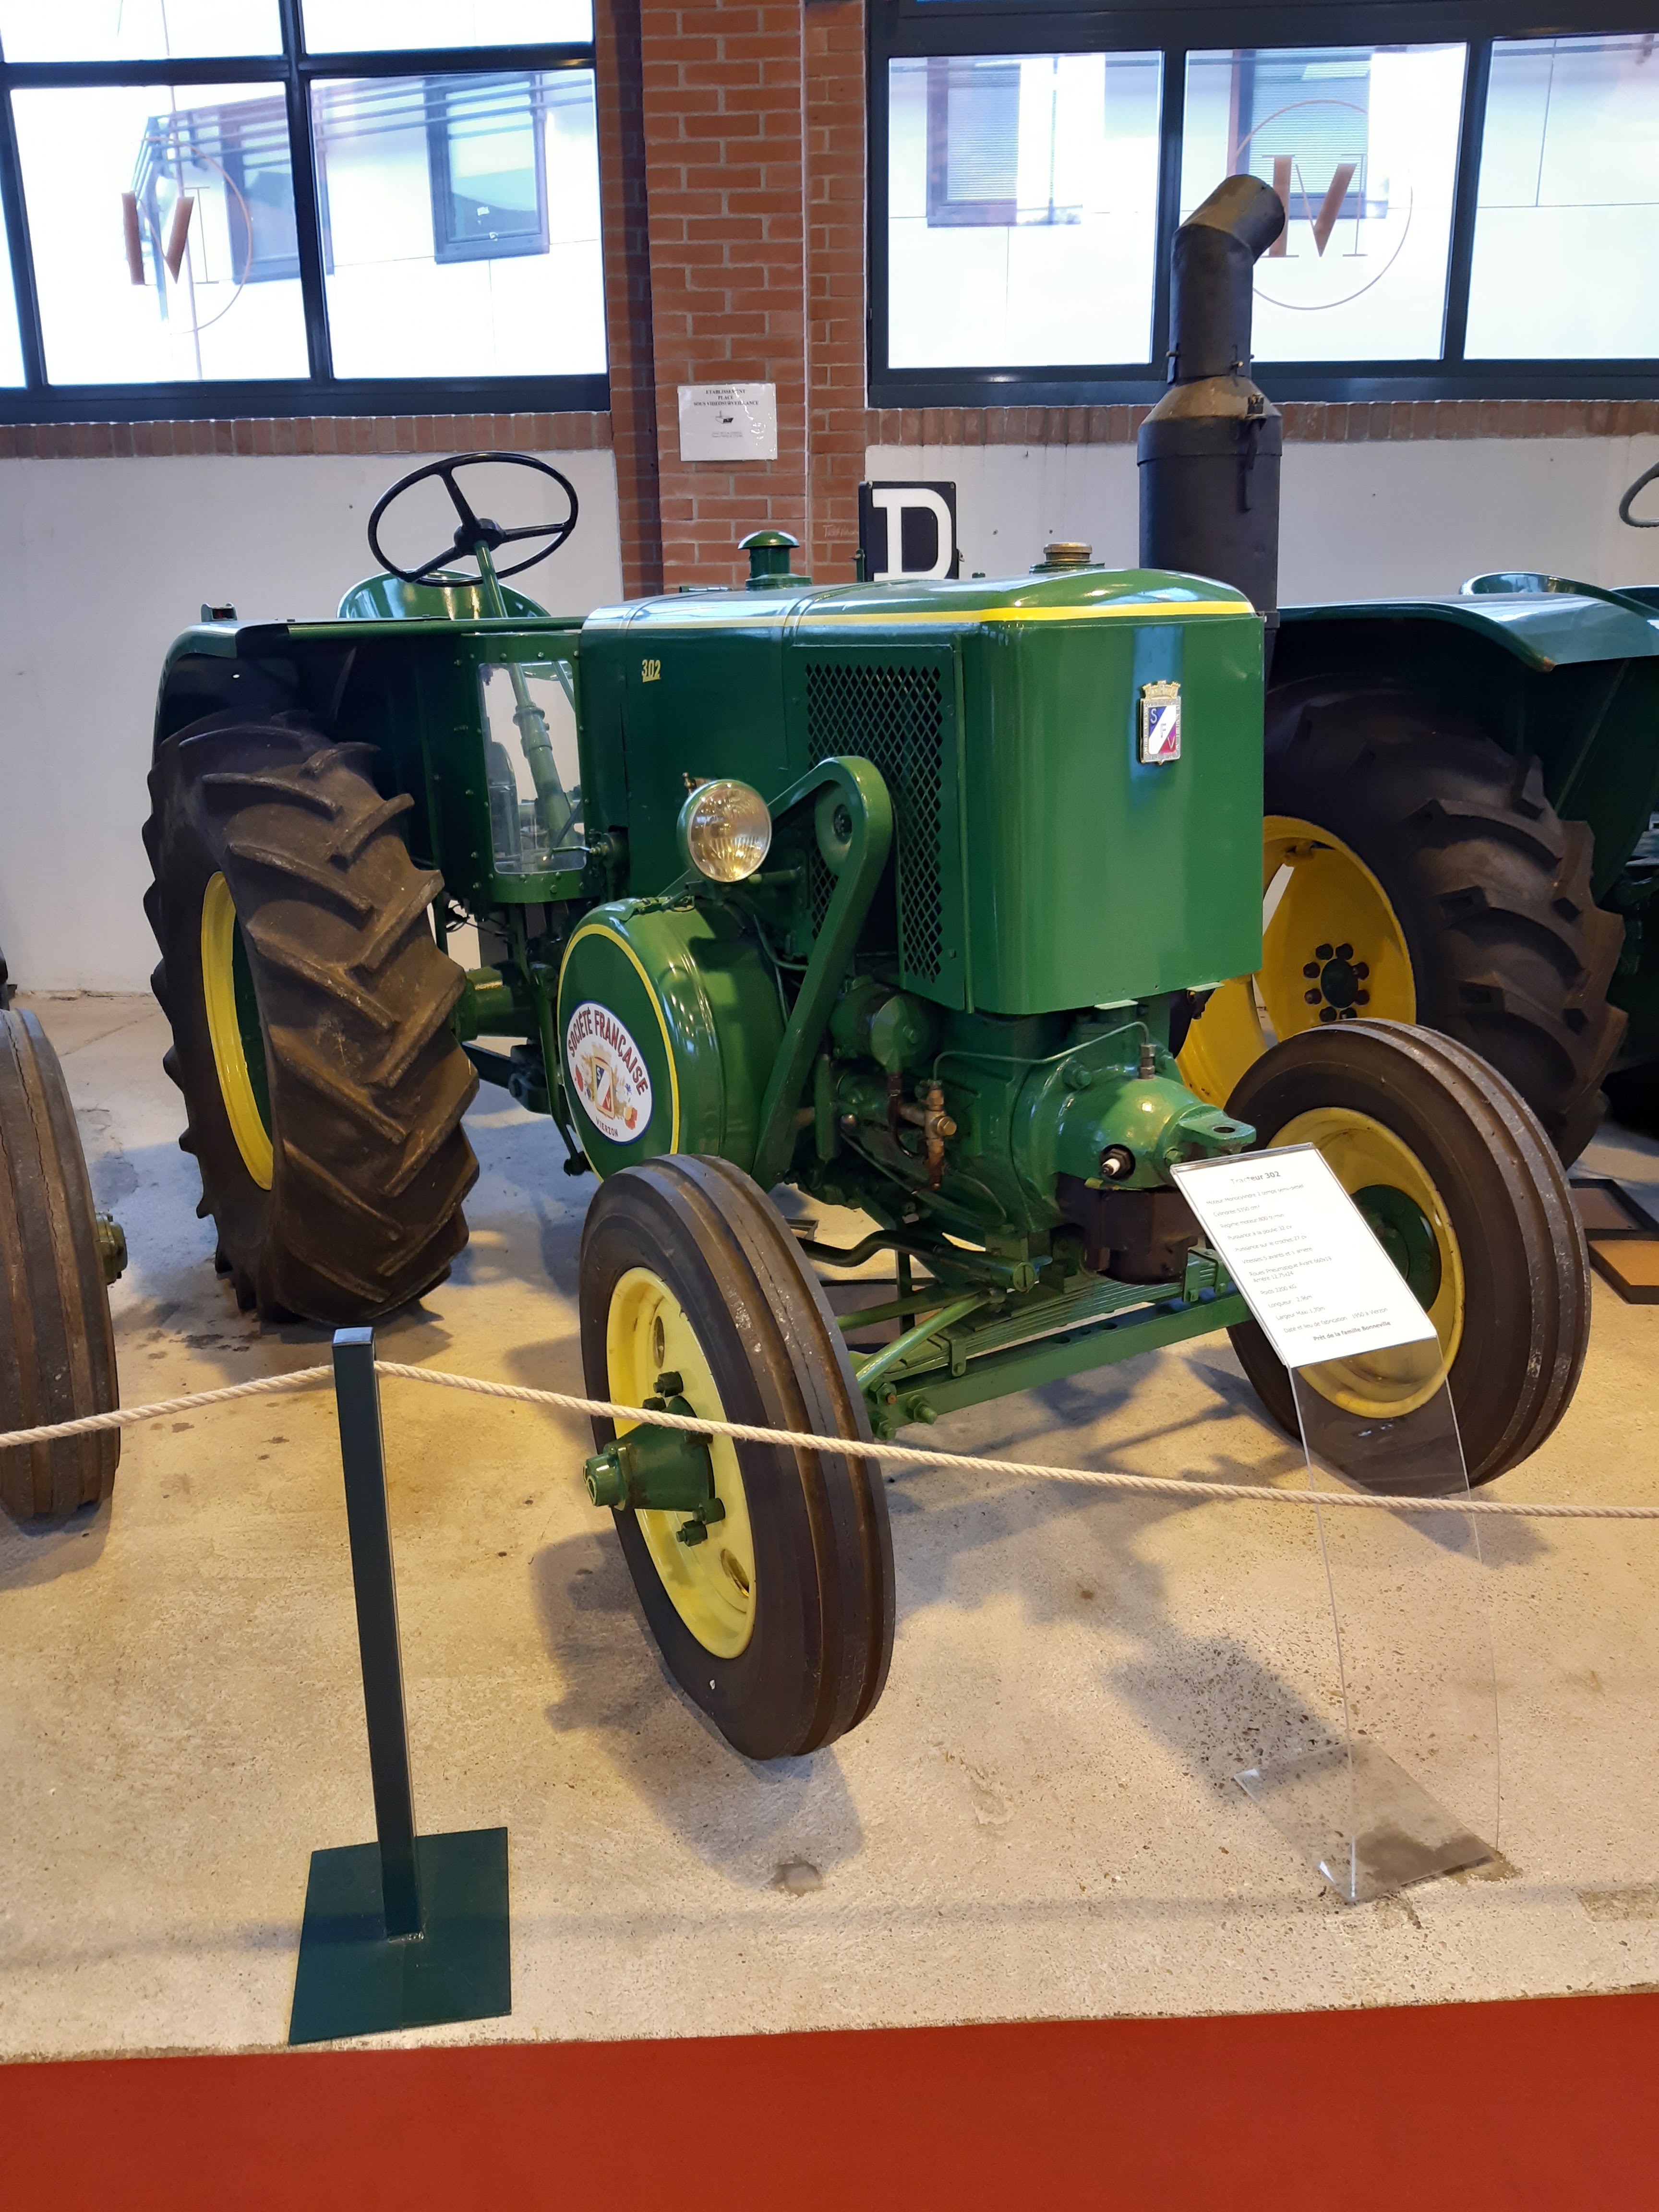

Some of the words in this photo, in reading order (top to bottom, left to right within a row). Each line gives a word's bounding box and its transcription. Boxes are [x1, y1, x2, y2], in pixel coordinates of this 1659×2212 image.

[872, 488, 952, 581] D
[642, 659, 661, 681] 302
[568, 1007, 593, 1057] SOCIÉTÉ
[594, 1010, 648, 1095] FRANÇAISE
[596, 1116, 618, 1137] VIERZON
[1361, 1322, 1391, 1331] Bonneville
